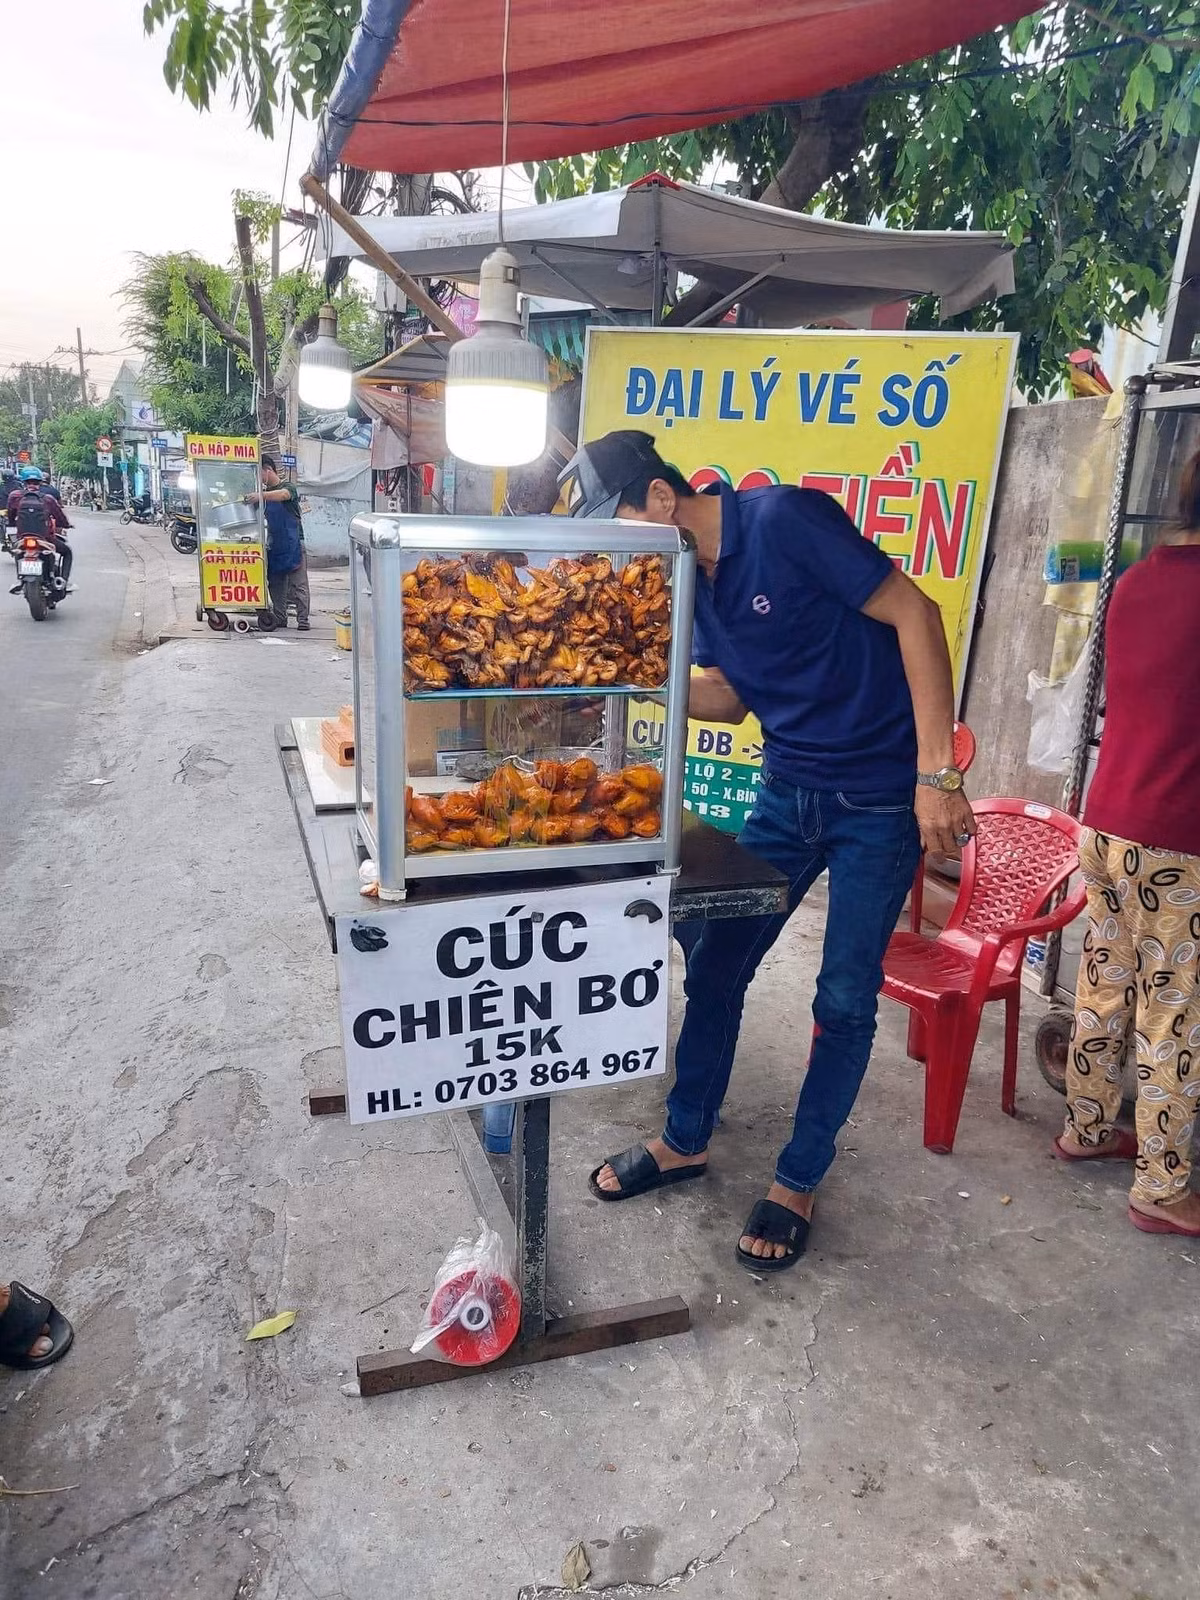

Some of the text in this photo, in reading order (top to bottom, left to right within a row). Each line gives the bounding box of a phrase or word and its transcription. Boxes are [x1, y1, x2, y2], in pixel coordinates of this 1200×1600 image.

[626, 353, 963, 429] ĐẠI LÝ VÉ SỐ
[190, 440, 255, 458] GÀ HẤP MÍA
[205, 545, 261, 565] GÀ HẤP
[219, 566, 249, 583] MÍA
[207, 585, 261, 603] 150K
[697, 728, 733, 756] ĐB
[694, 762, 715, 780] LỘ
[721, 767, 733, 781] 2
[691, 781, 709, 796] 50
[352, 958, 664, 1049] CHIÊN BƠ
[465, 1024, 563, 1069] 15K
[366, 1046, 660, 1115] HL: 0703 864 967
